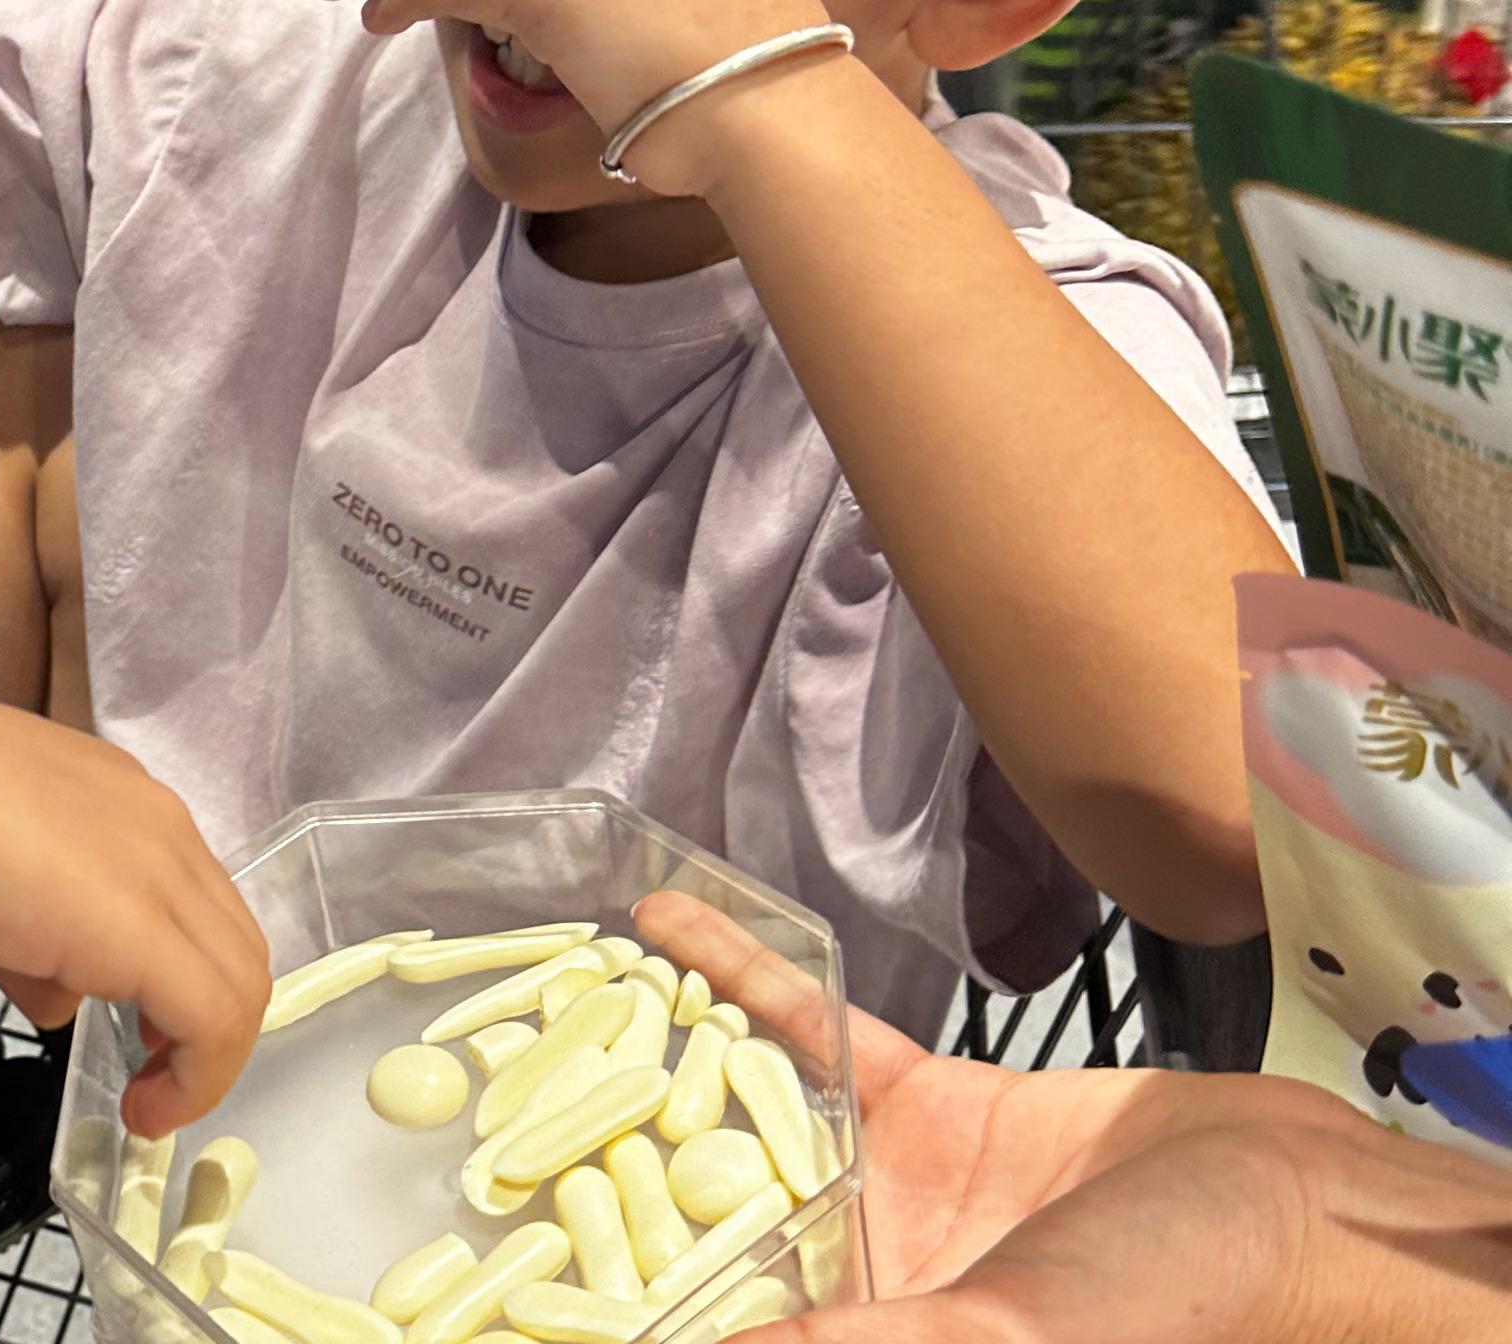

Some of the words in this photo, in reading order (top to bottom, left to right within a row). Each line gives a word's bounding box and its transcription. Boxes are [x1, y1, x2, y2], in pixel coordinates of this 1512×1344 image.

[332, 481, 403, 547] ZERO
[410, 537, 451, 573] TO
[457, 565, 534, 611] ONE
[341, 544, 490, 642] EMPOWERMENT
